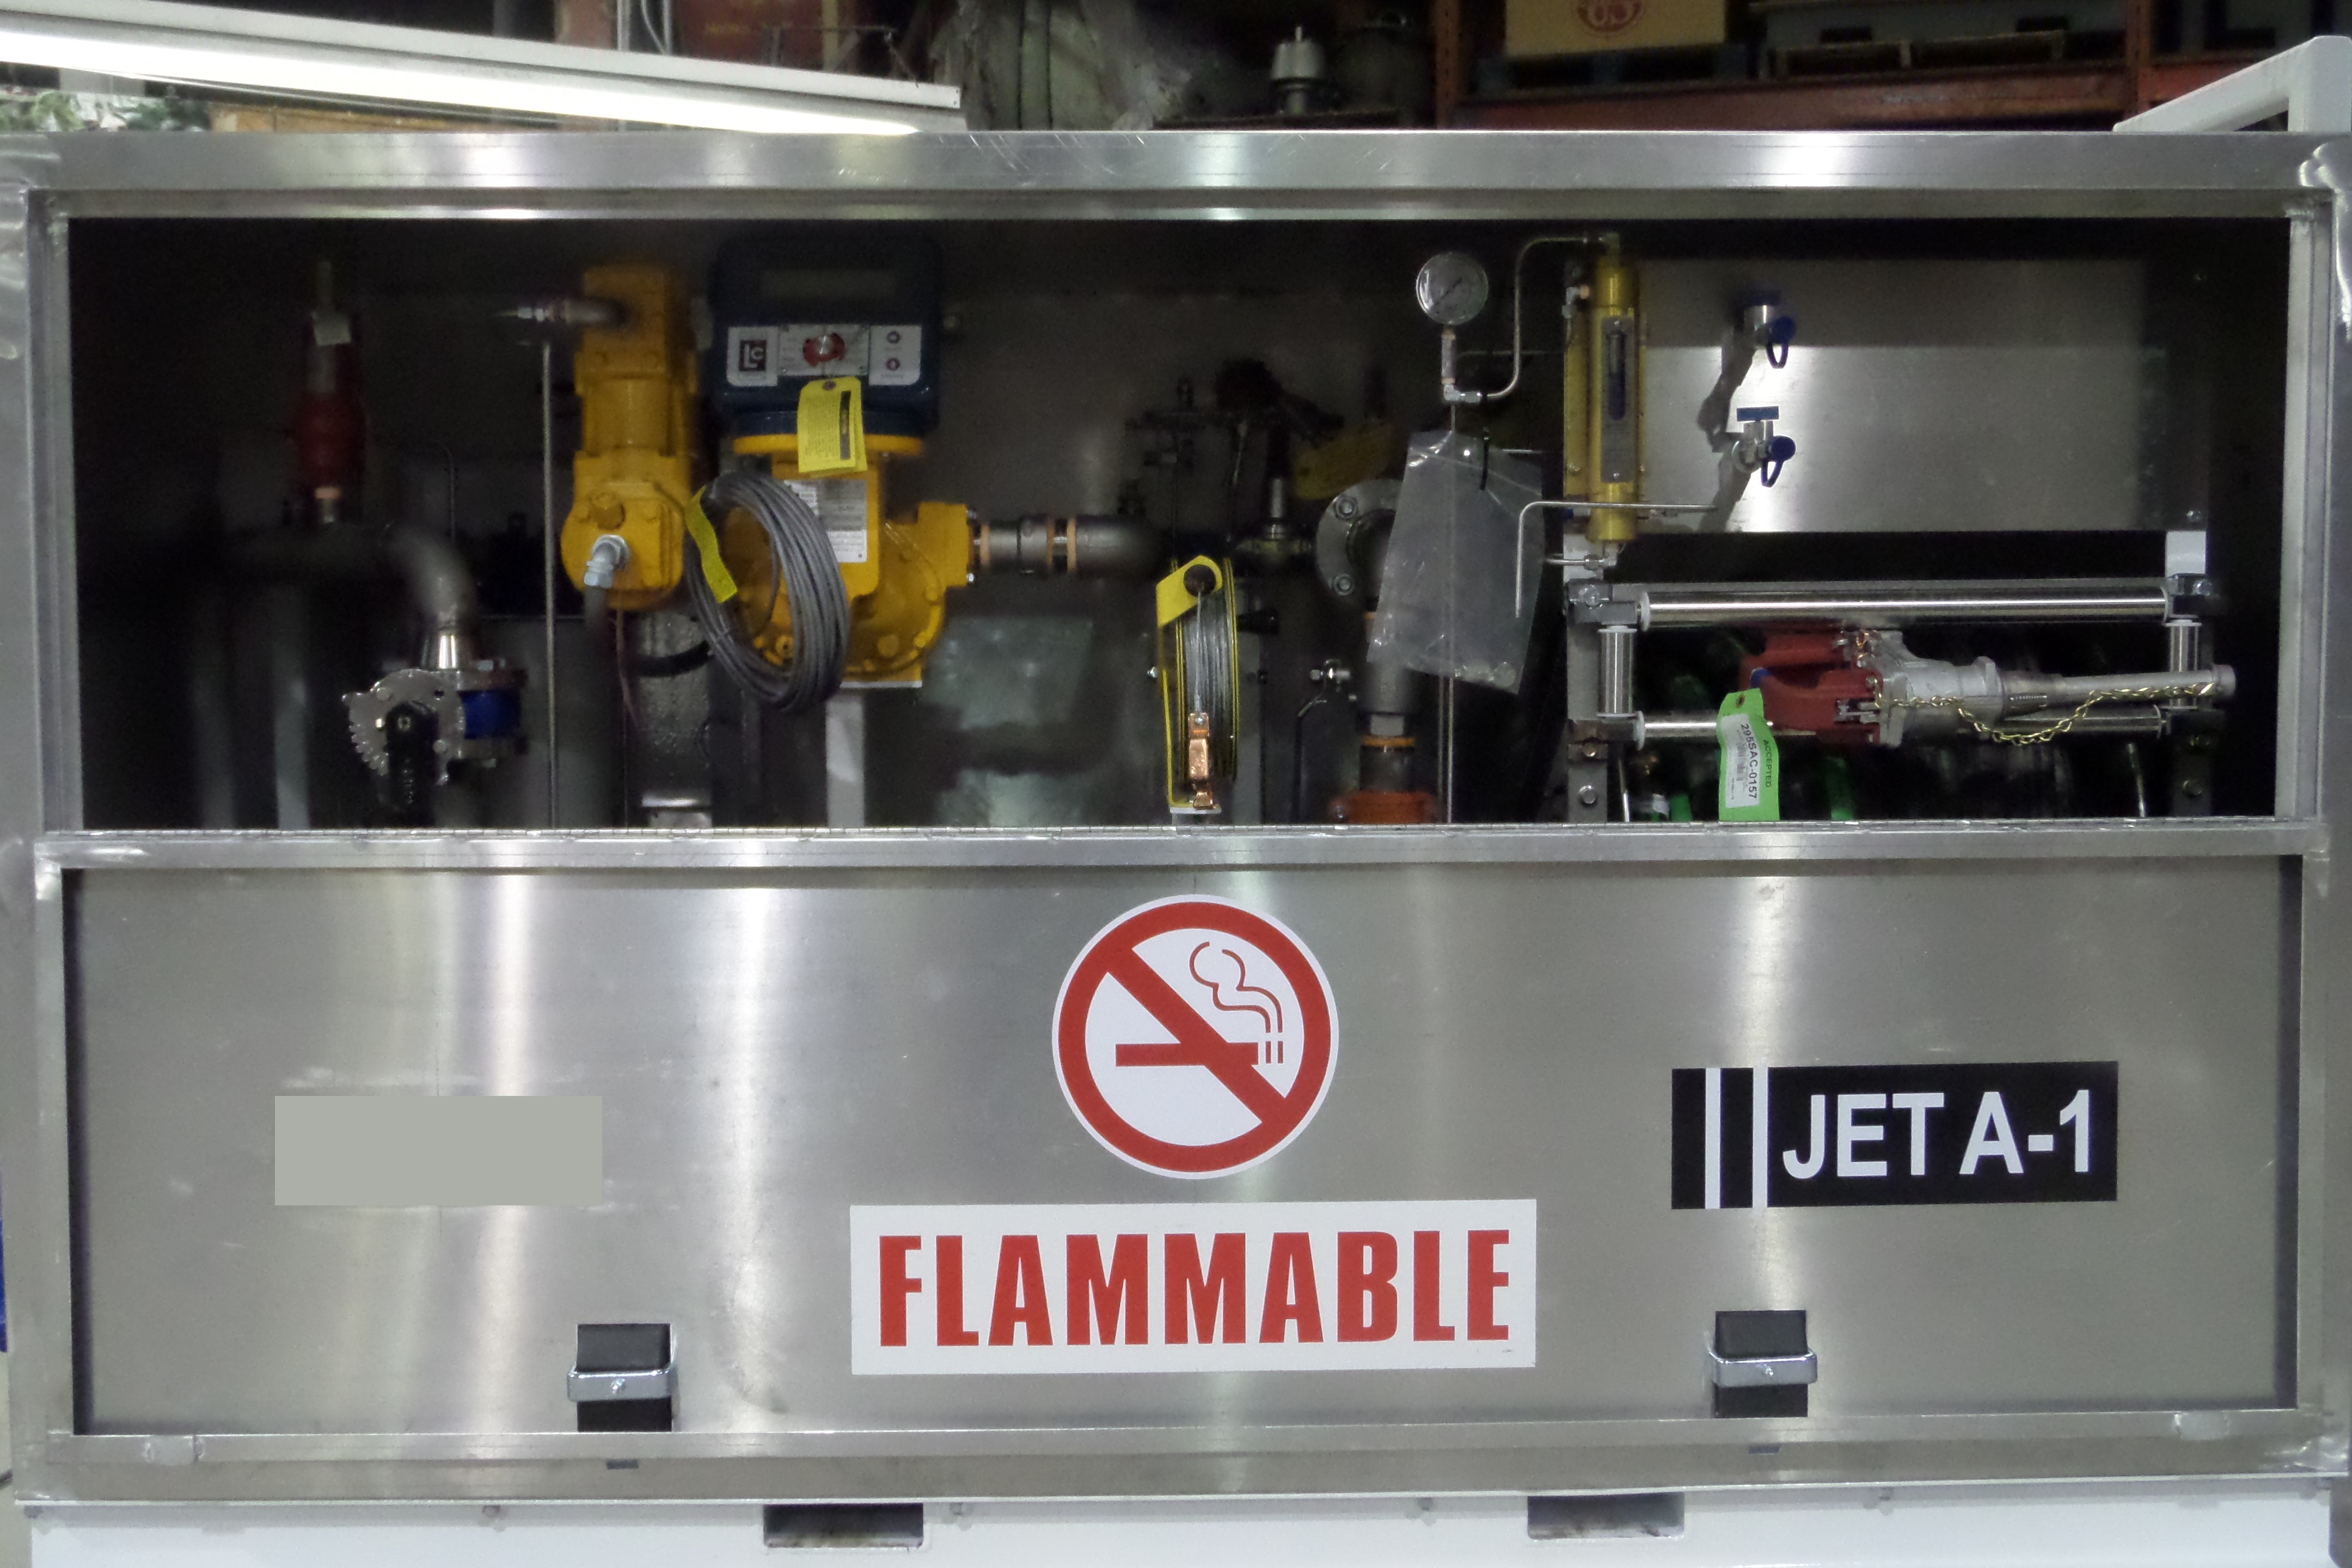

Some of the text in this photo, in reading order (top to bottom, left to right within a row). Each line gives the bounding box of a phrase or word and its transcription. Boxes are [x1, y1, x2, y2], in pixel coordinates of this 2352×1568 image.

[1741, 724, 1759, 799] 295SAC-0157
[1763, 739, 1772, 788] ACCEPTED
[1783, 1089, 2090, 1179] JET A-1
[879, 1229, 1509, 1346] FLAMMABLE
